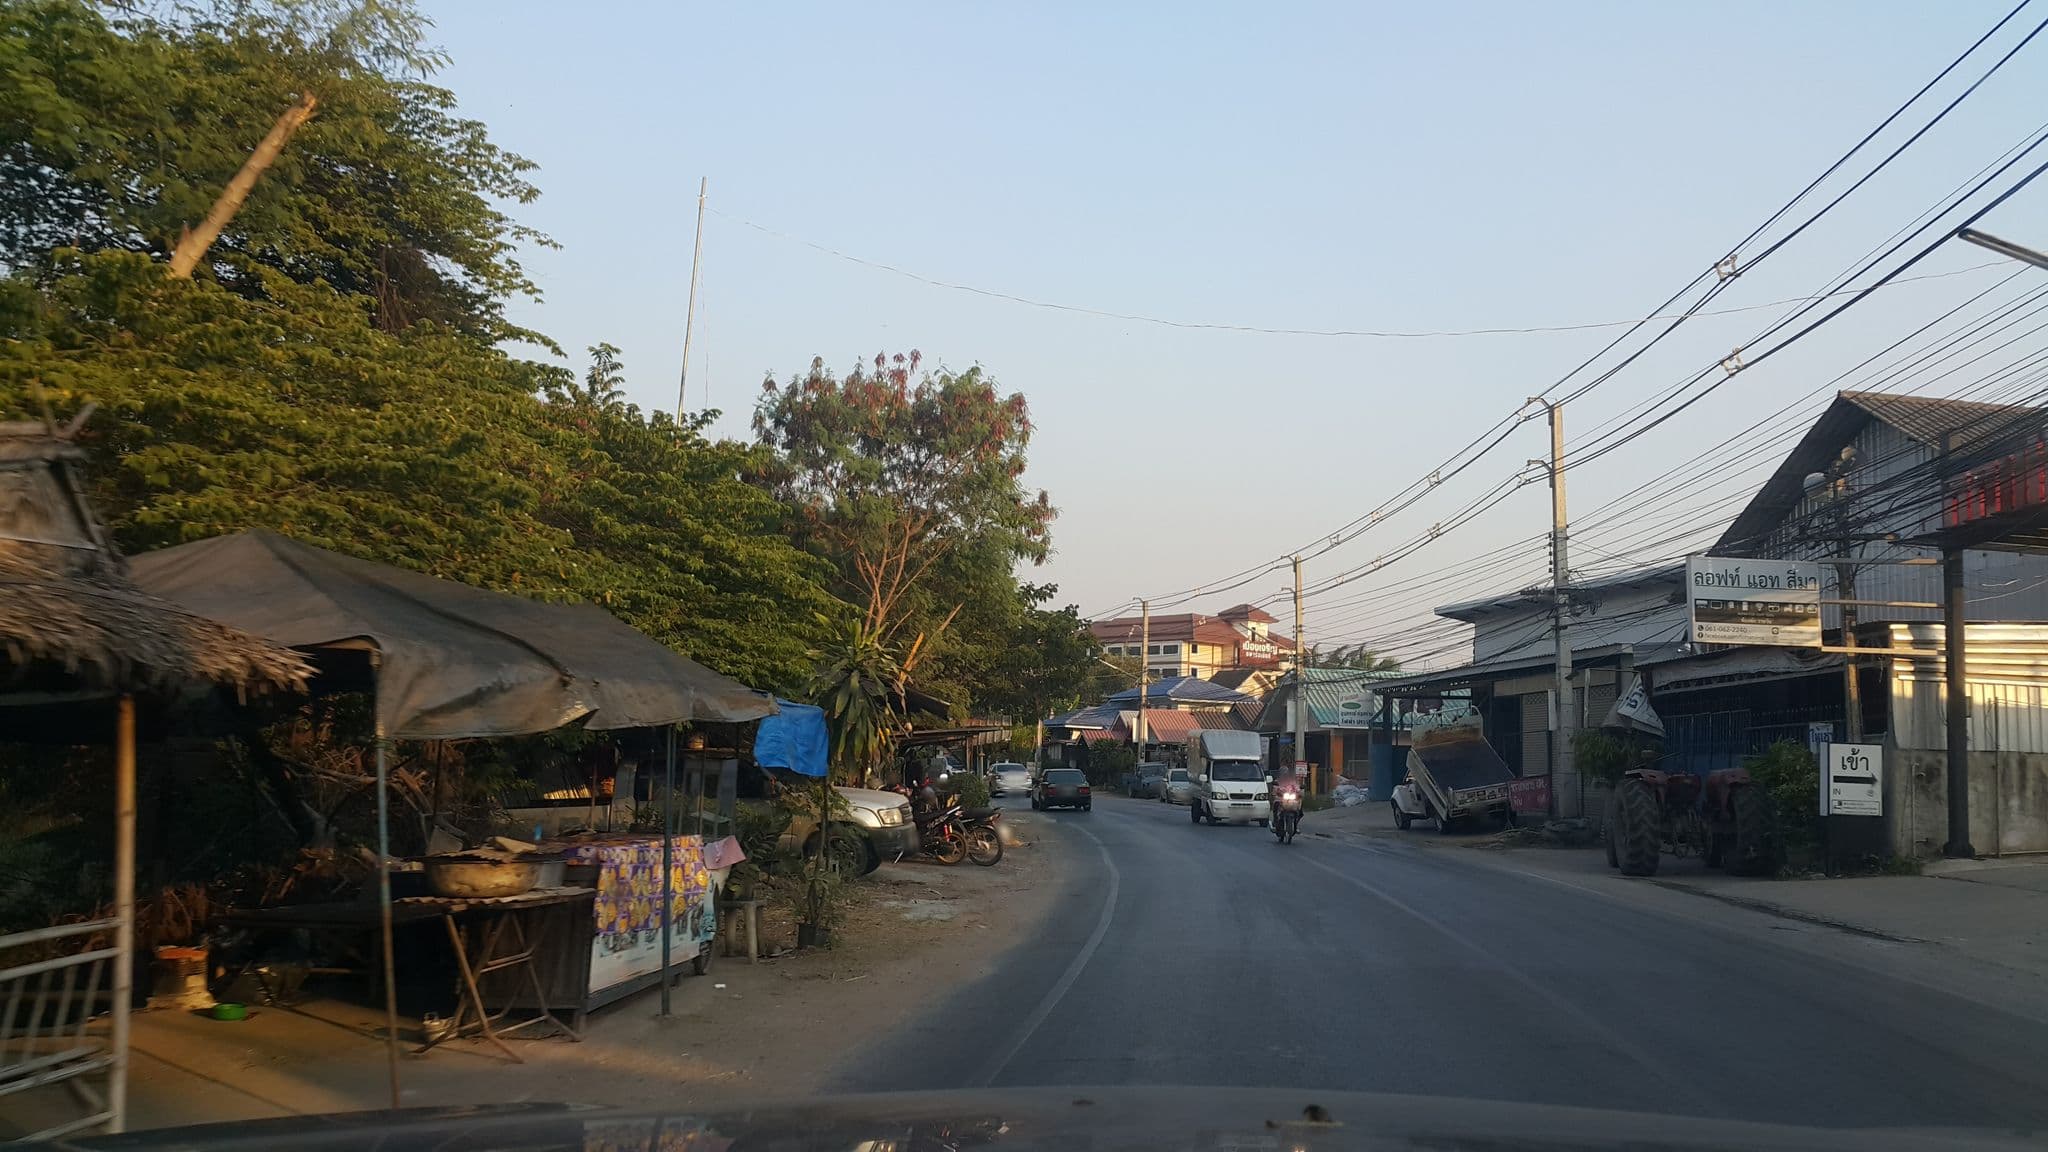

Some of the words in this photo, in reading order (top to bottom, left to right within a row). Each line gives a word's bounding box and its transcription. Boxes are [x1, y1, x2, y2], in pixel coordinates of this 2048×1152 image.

[1694, 566, 1741, 586] ลอฟท์
[1747, 573, 1780, 588] แอท
[1786, 568, 1817, 589] สีมา
[1841, 747, 1869, 771] เข้า
